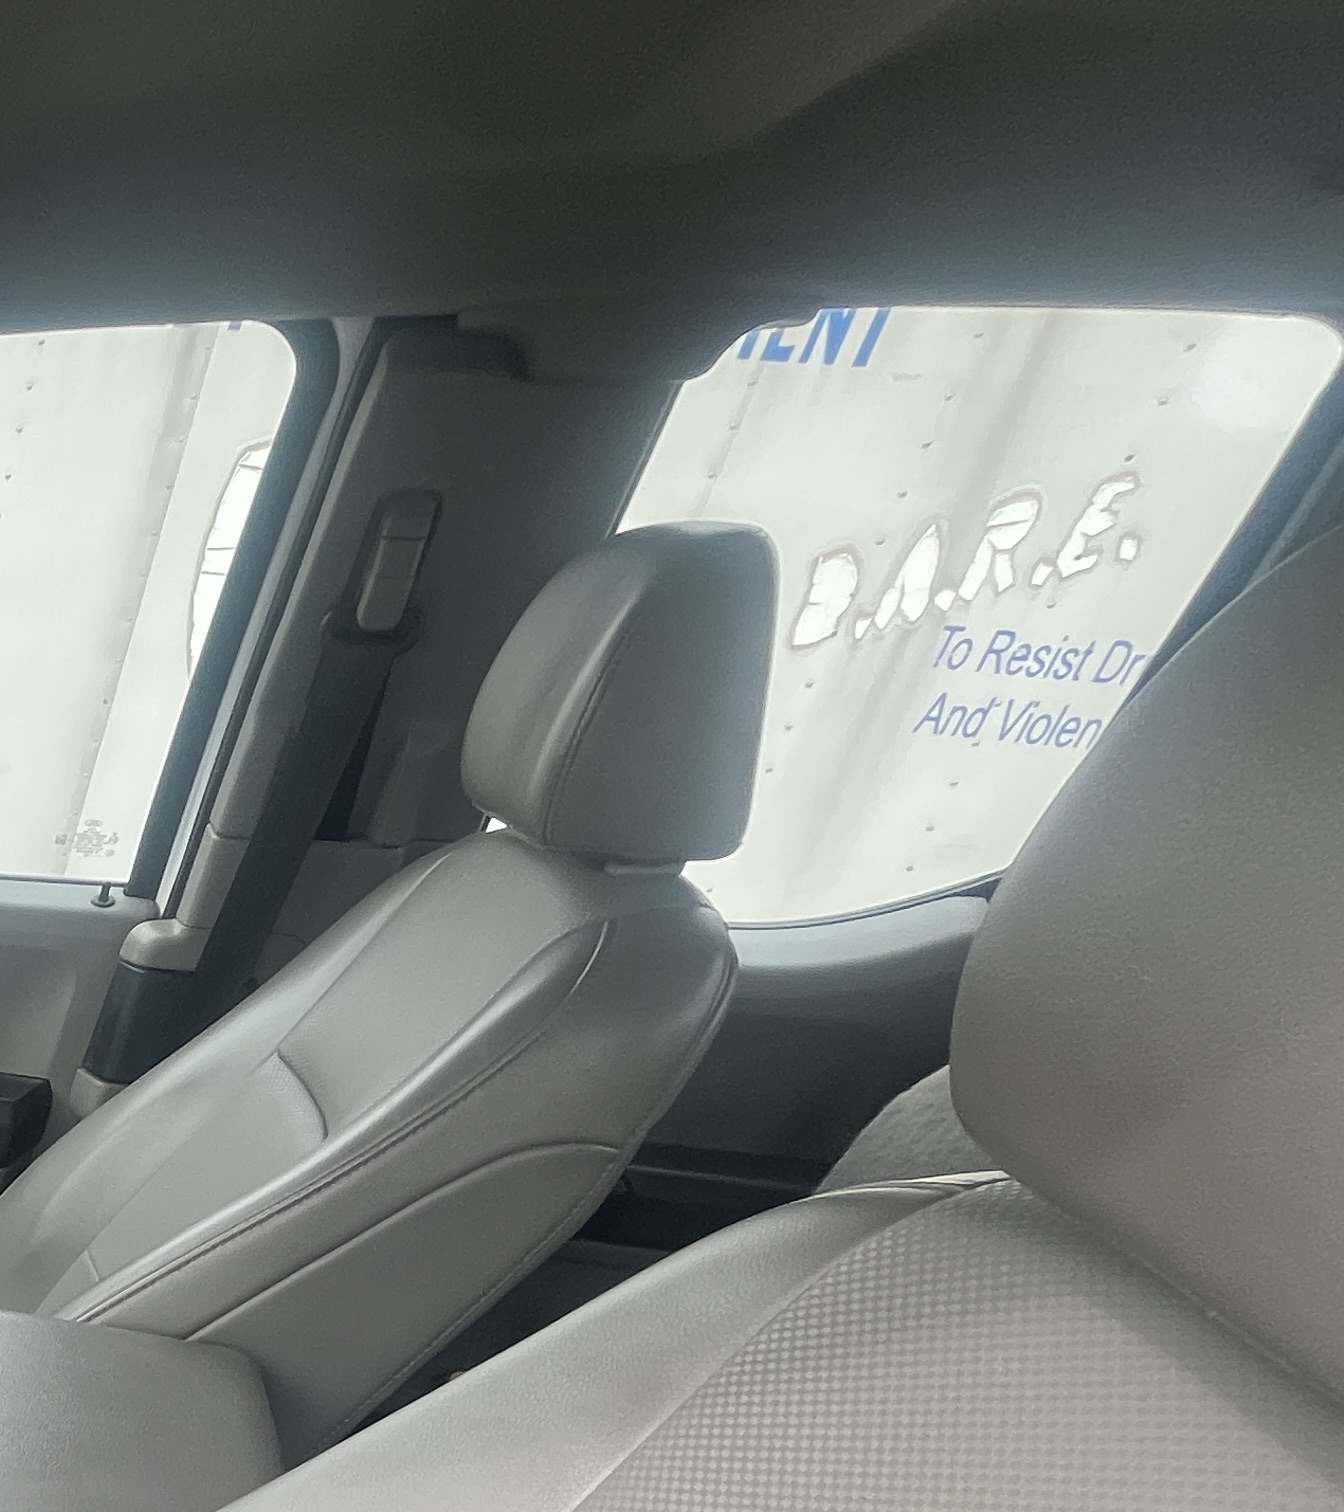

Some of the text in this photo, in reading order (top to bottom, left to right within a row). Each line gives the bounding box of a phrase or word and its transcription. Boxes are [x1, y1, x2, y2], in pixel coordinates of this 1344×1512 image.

[932, 624, 1146, 686] To Resist Dr
[912, 692, 1104, 749] And Violen
